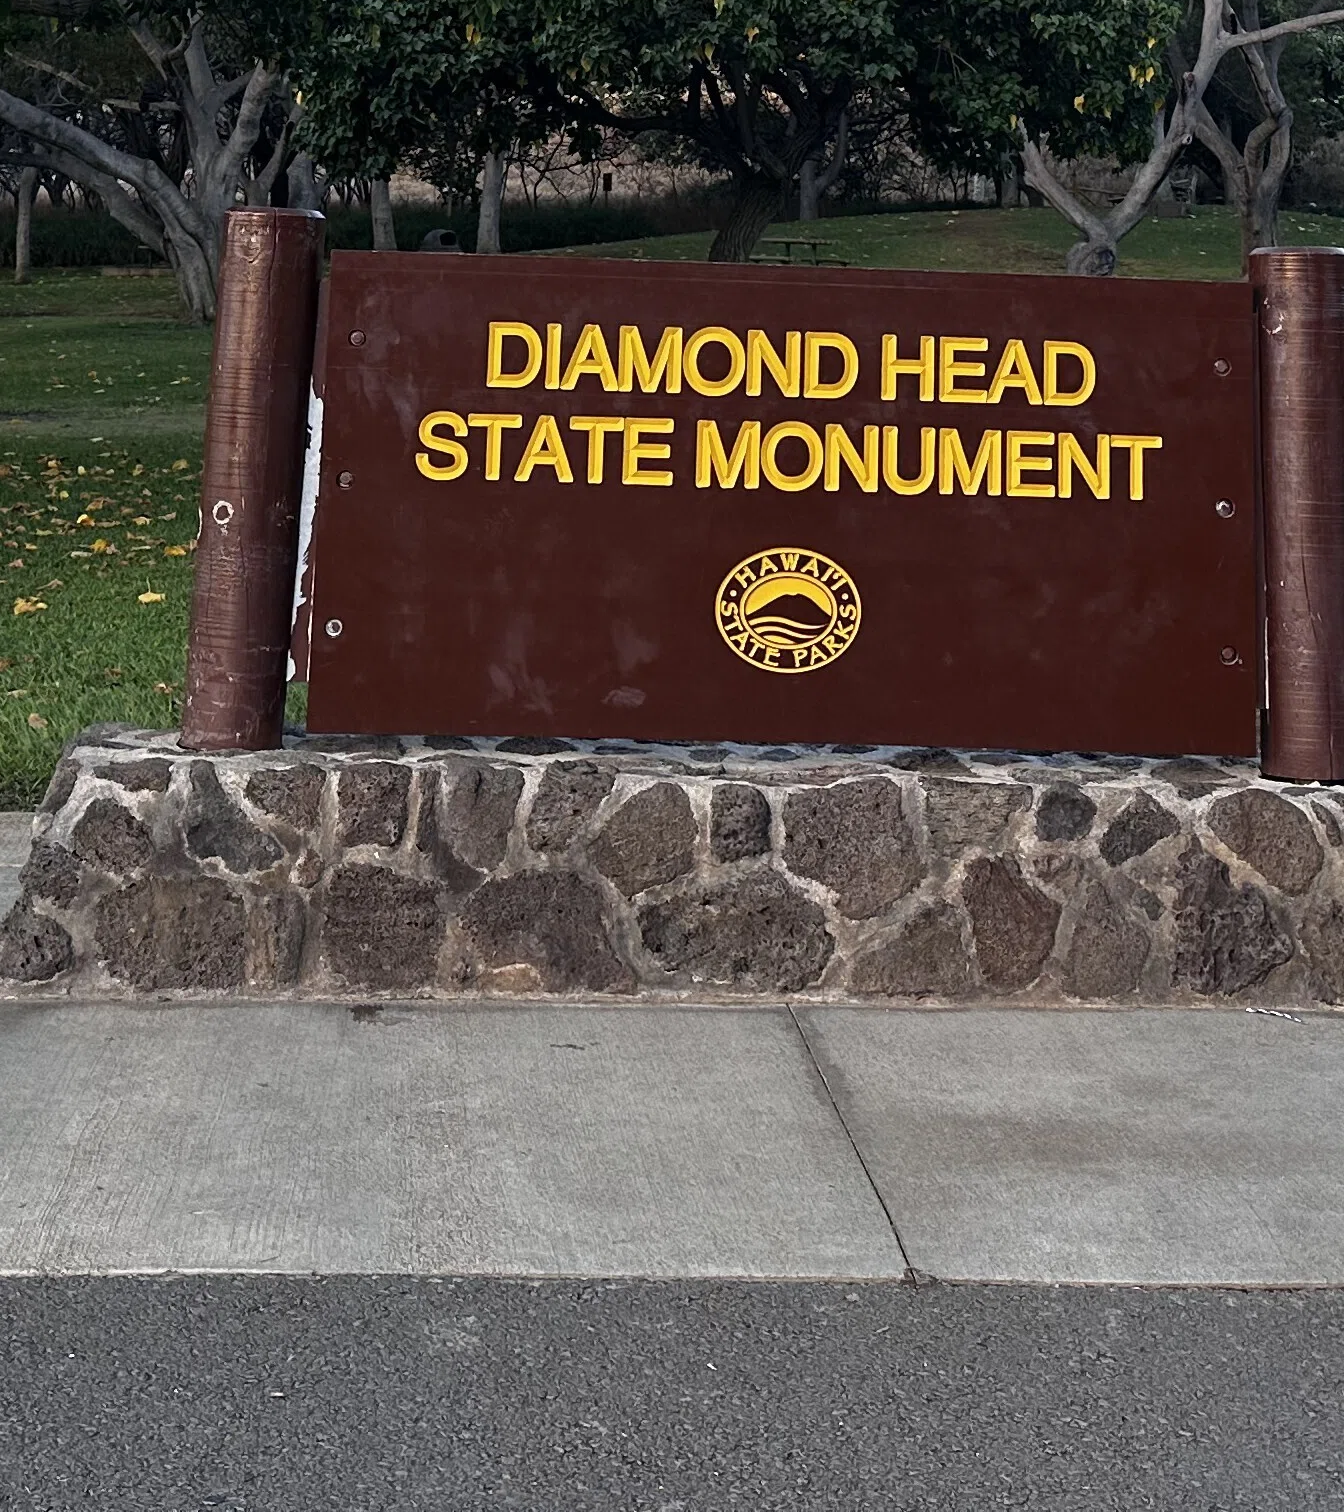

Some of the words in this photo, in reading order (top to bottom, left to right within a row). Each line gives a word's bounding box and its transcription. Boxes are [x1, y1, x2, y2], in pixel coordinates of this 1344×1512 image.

[486, 322, 859, 399] DIAMOND
[880, 333, 1096, 407] HEAD
[415, 411, 675, 487] STATE
[694, 419, 1162, 500] MONUMENT
[720, 600, 781, 667] STATE
[792, 603, 857, 668] PARKS
